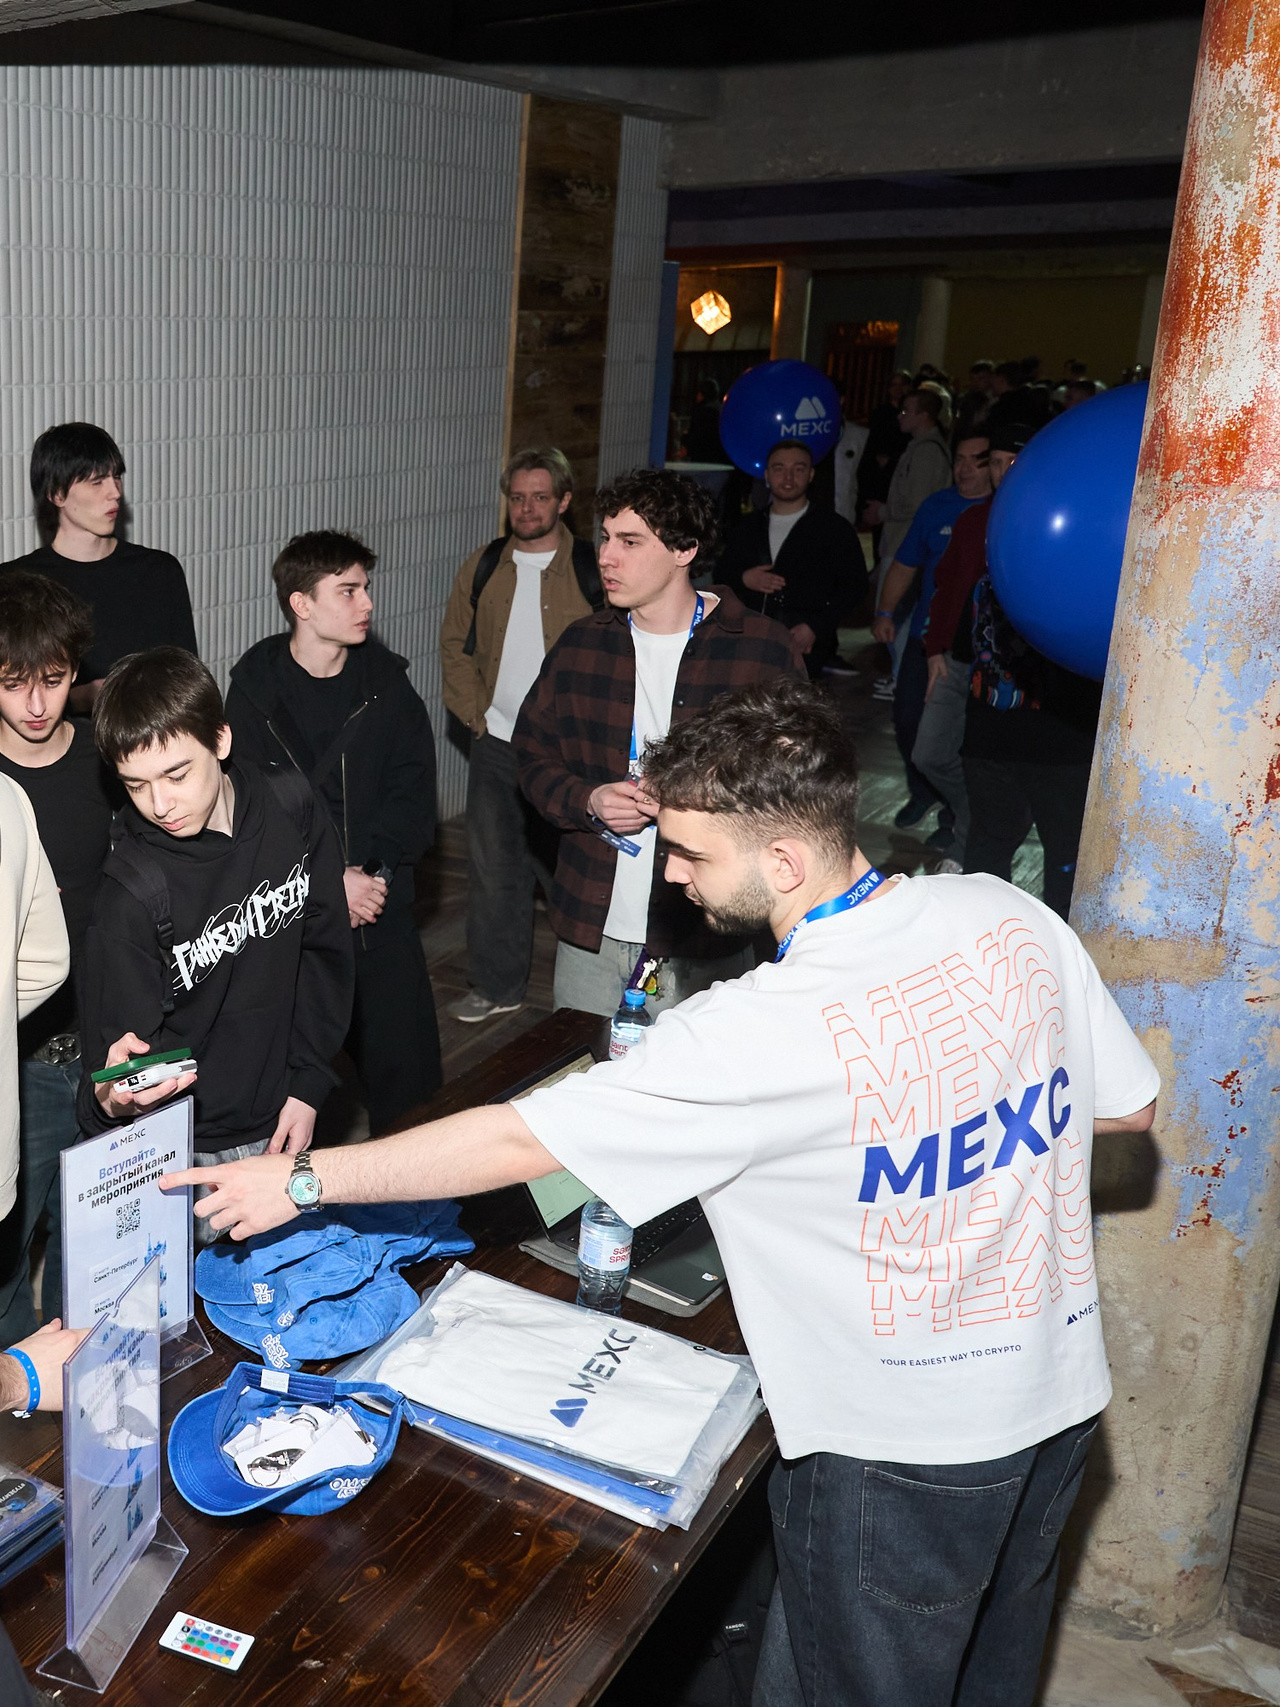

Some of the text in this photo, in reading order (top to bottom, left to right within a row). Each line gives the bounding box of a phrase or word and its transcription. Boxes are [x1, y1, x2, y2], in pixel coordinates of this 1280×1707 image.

[781, 420, 832, 436] MEXC
[847, 880, 874, 905] MEXC
[120, 1128, 146, 1146] MEXC
[858, 1067, 1071, 1203] MEXC
[99, 1147, 156, 1179] Вступайте
[78, 1150, 176, 1202] в закрытый канал
[91, 1168, 164, 1209] мероприятия
[94, 1301, 114, 1314] Москва
[1079, 1300, 1100, 1319] MEX
[568, 1328, 637, 1394] MEXC
[880, 1344, 1022, 1366] YOUR EASIEST WAY TO CRYPTO
